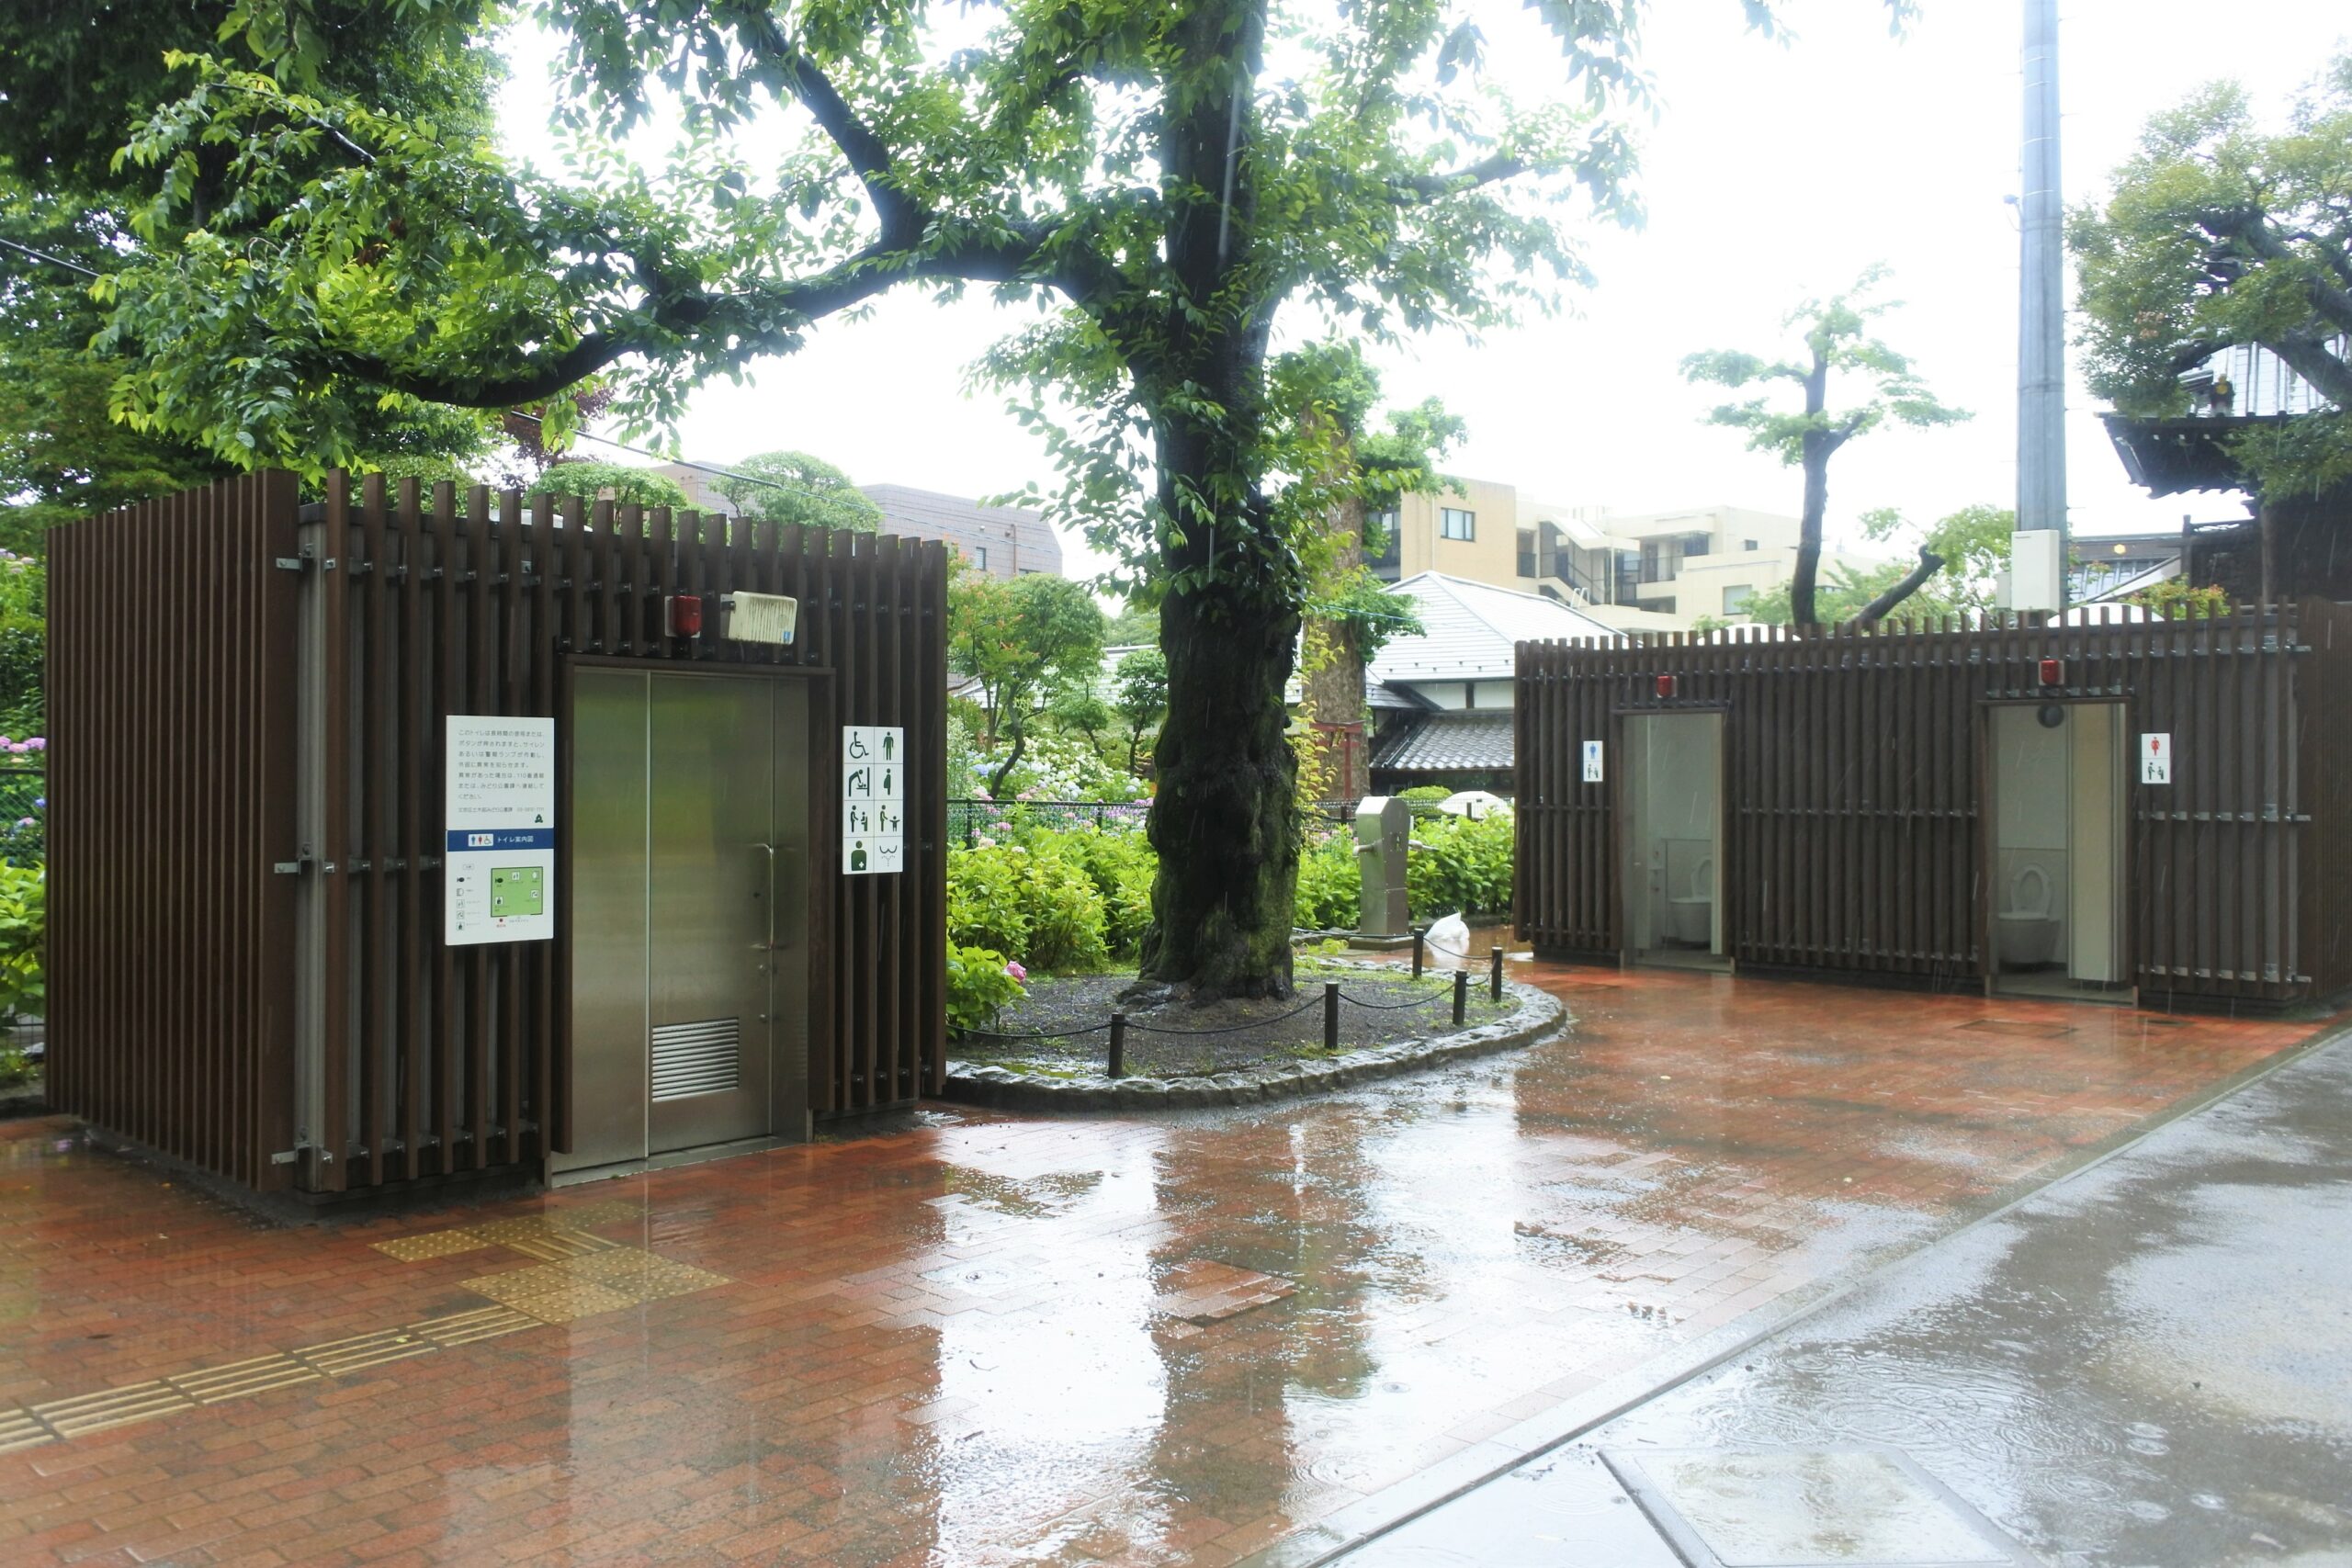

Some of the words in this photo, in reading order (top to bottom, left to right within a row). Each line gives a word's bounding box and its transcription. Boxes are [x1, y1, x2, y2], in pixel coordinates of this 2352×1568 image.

[498, 835, 534, 843] トイレ案内図
